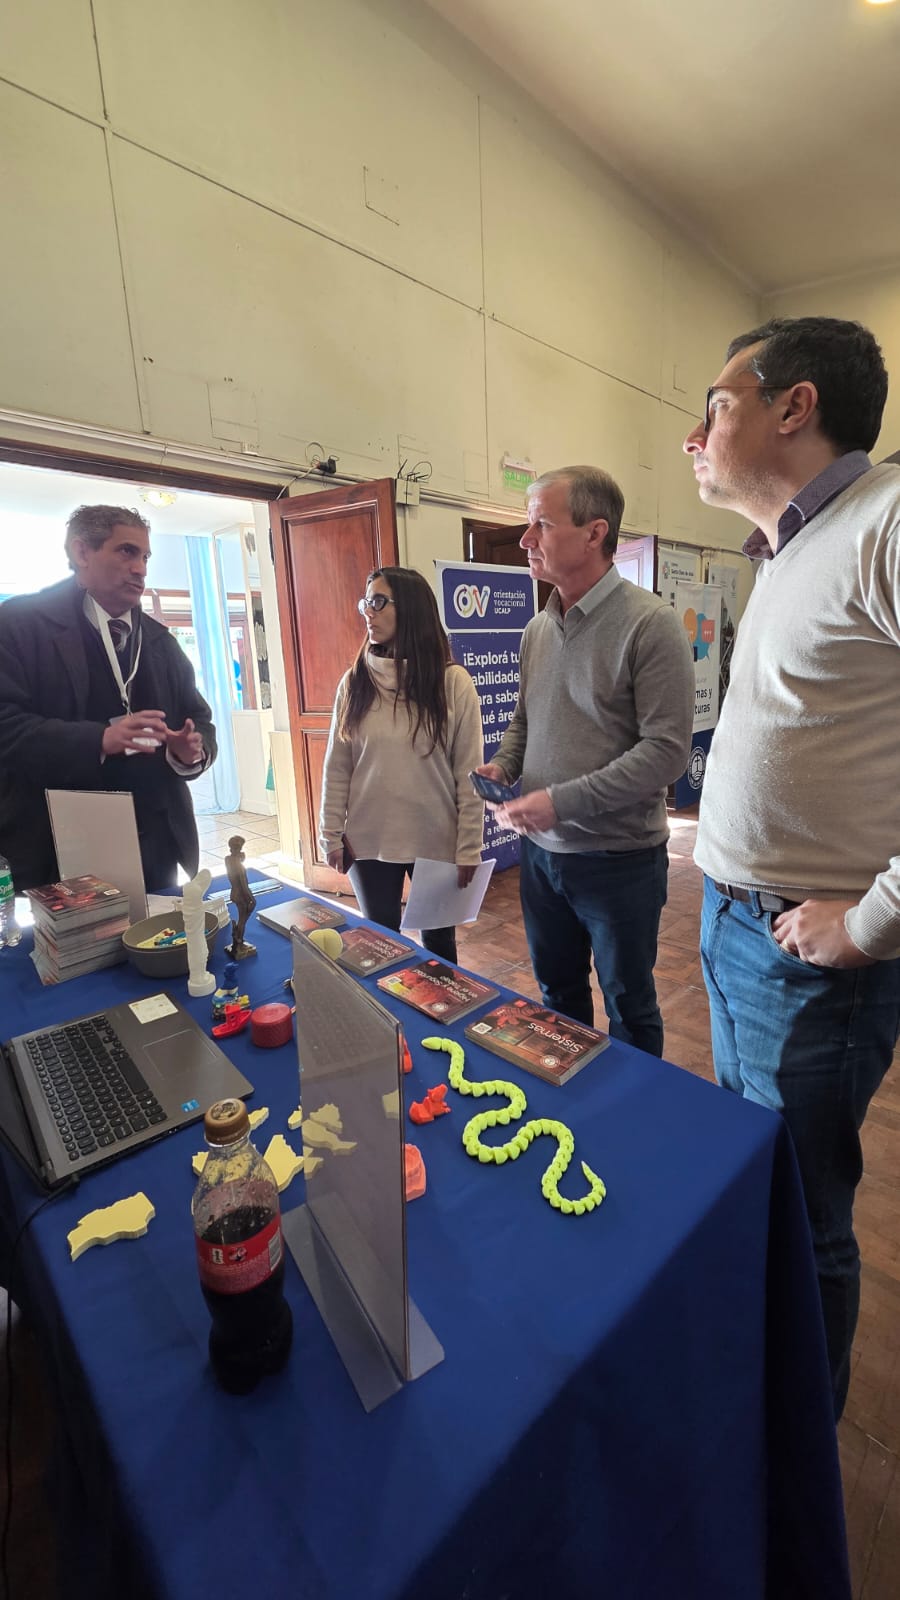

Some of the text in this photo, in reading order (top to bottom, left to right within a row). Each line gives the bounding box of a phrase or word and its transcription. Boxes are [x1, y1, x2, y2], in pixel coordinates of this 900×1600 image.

[493, 589, 526, 600] orientación
[493, 599, 526, 608] vocacional
[494, 607, 511, 615] UCALP
[510, 651, 520, 664] tu
[472, 669, 520, 686] abilidade
[477, 689, 519, 705] ara sabe
[694, 703, 711, 714] turas
[482, 709, 514, 725] ué áre
[527, 1022, 583, 1053] Sistemas
